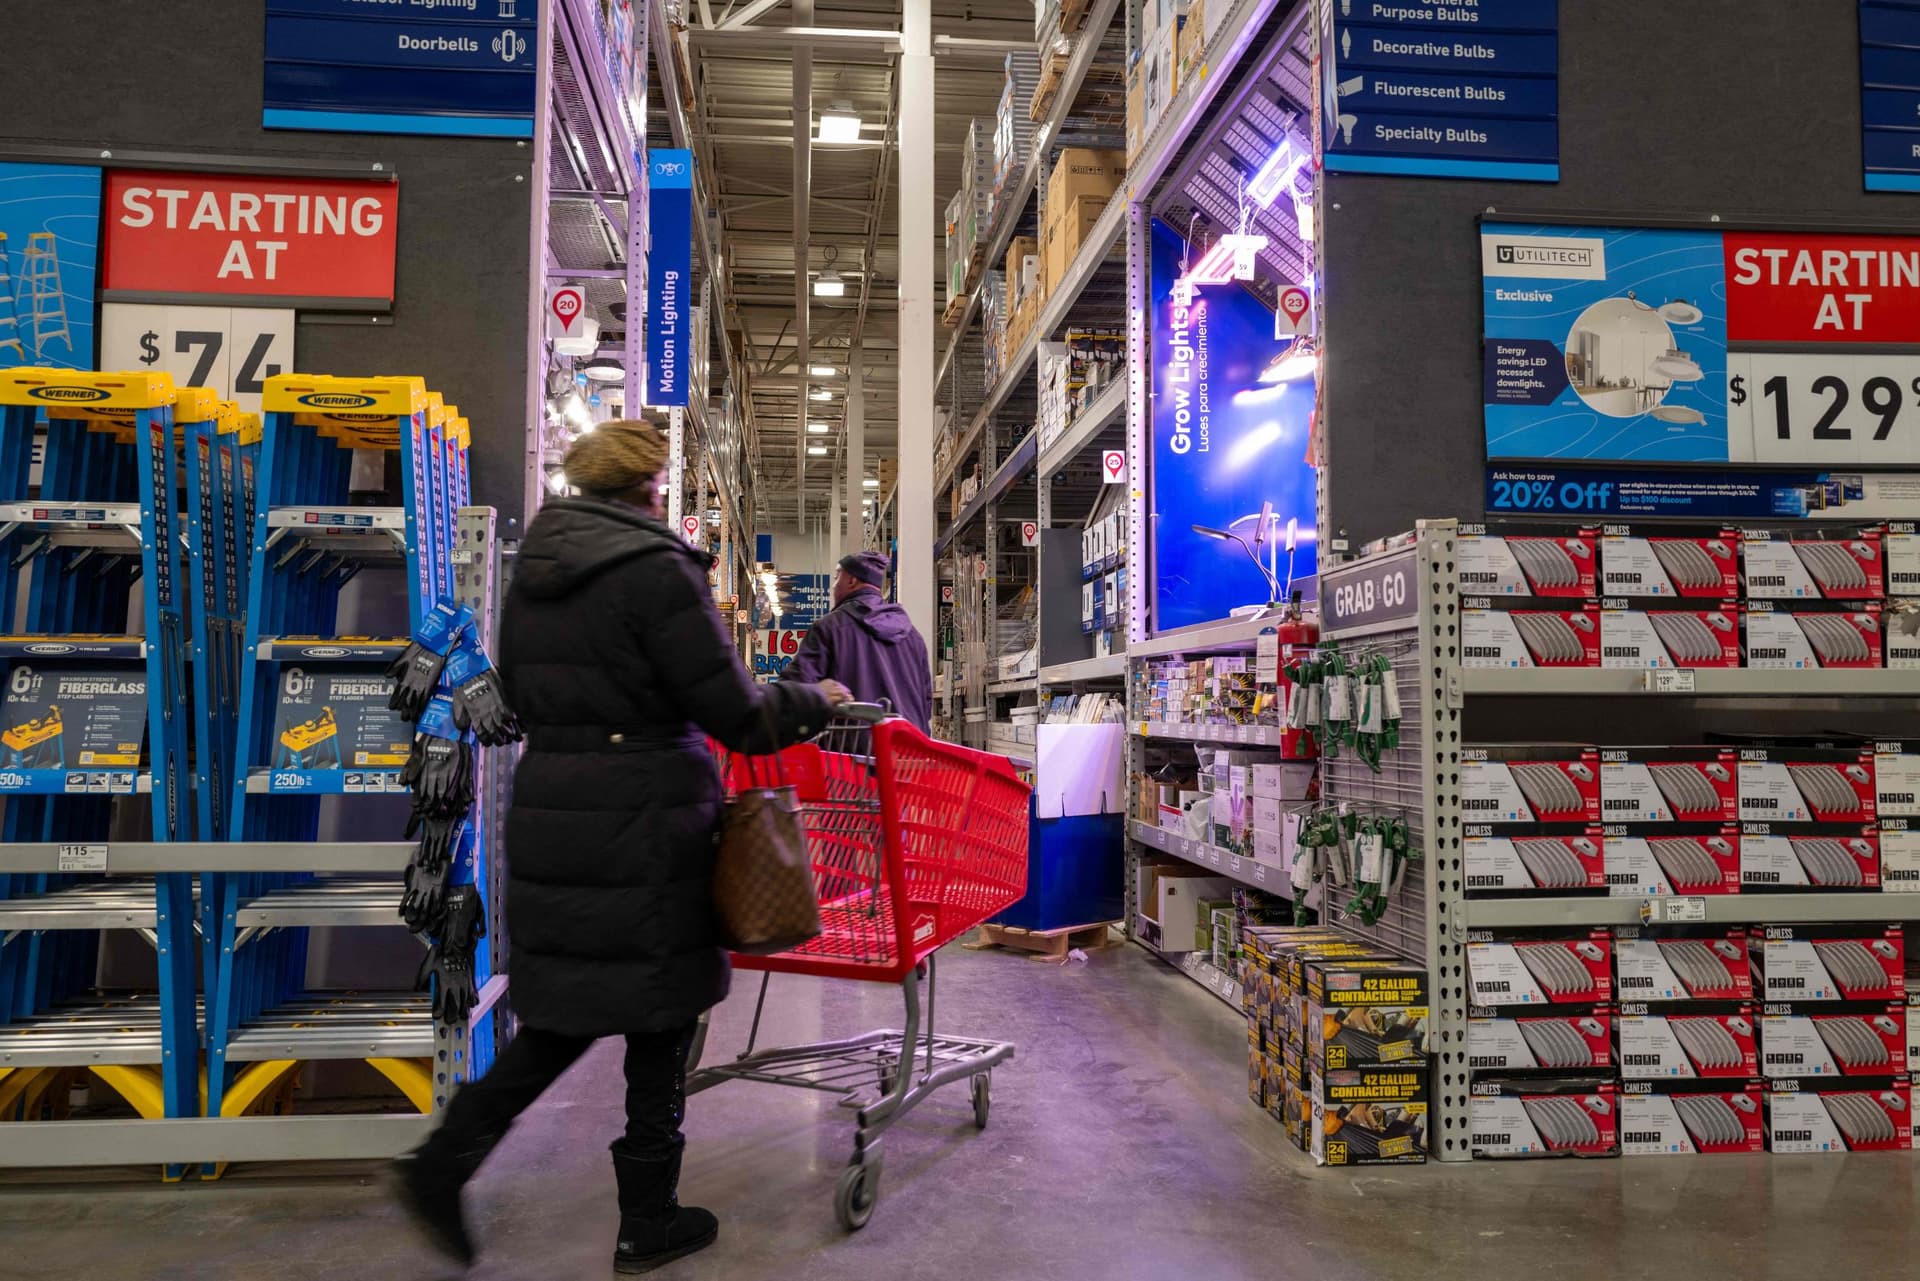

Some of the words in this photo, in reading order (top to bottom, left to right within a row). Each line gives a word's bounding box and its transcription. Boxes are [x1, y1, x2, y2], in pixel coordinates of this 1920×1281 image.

[1373, 4, 1433, 21] Purpose
[1438, 8, 1478, 22] Bulbs
[398, 35, 478, 52] Doorbells
[1373, 40, 1450, 56] Decorative
[1454, 44, 1495, 58] Bulbs
[1374, 82, 1460, 98] Fluorescent
[1464, 86, 1506, 100] Bulbs
[1375, 125, 1442, 143] Specialty
[1446, 128, 1488, 143] Bulbs
[120, 188, 384, 236] STARTING
[217, 241, 288, 280] AT
[1516, 250, 1587, 262] UTILITECH
[1734, 248, 1920, 288] STARTIN
[1496, 288, 1552, 302] Exclusive
[560, 300, 574, 310] 20
[661, 271, 678, 334] Lighting
[1288, 298, 1302, 307] 23
[1813, 294, 1872, 331] AT
[1169, 307, 1194, 383] Lights
[1196, 307, 1208, 380] crecimiento
[1497, 346, 1526, 356] Energy
[660, 339, 674, 392] Motion
[1497, 357, 1529, 368] savings
[1531, 358, 1547, 366] LED
[1497, 368, 1534, 378] recessed
[1497, 378, 1545, 390] downlights.
[45, 388, 96, 398] WERNER
[1200, 384, 1211, 412] para
[313, 396, 362, 405] WERNER
[1170, 389, 1191, 454] Grow
[1198, 416, 1208, 452] Luces
[1493, 472, 1508, 480] Ask
[1510, 472, 1526, 480] how
[1494, 481, 1554, 508] 20%
[1620, 496, 1630, 504] Up
[1641, 495, 1659, 504] $100
[1660, 496, 1692, 504] discount
[1336, 580, 1374, 618] GRAB
[1383, 572, 1405, 608] GO
[58, 682, 145, 694] FIBERGLASS
[330, 684, 394, 696] FIBERGLA
[0, 772, 24, 786] 50lb
[1363, 978, 1378, 990] 42
[1379, 978, 1417, 990] GALLON
[1330, 991, 1399, 1002] CONTRACTOR
[1328, 1049, 1344, 1058] 24
[1364, 1074, 1378, 1085] 42
[1379, 1074, 1417, 1085] GALLON
[1331, 1086, 1399, 1097] CONTRACTOR
[1330, 1144, 1344, 1154] 24
